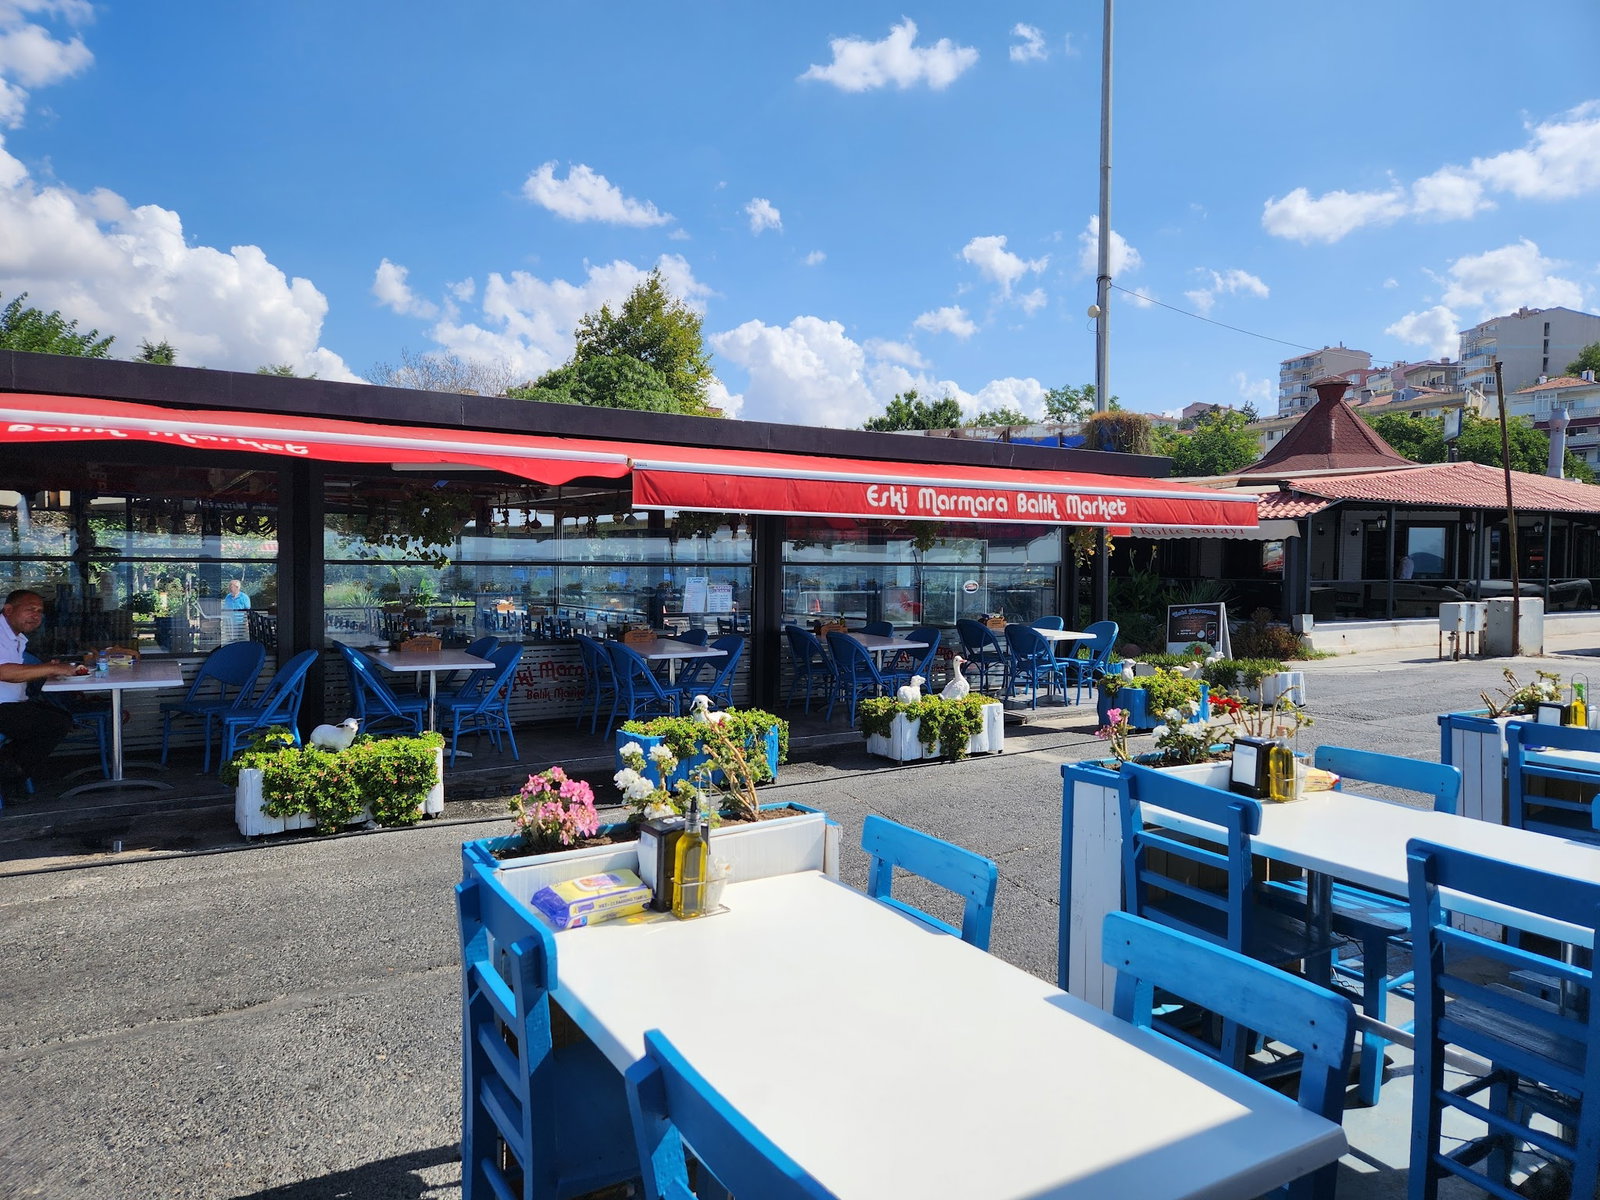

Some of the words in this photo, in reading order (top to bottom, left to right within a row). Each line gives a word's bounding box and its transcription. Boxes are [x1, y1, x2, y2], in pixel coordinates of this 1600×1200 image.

[866, 485, 908, 514] Eski
[918, 488, 1008, 517] Marmara
[1066, 495, 1127, 520] Market
